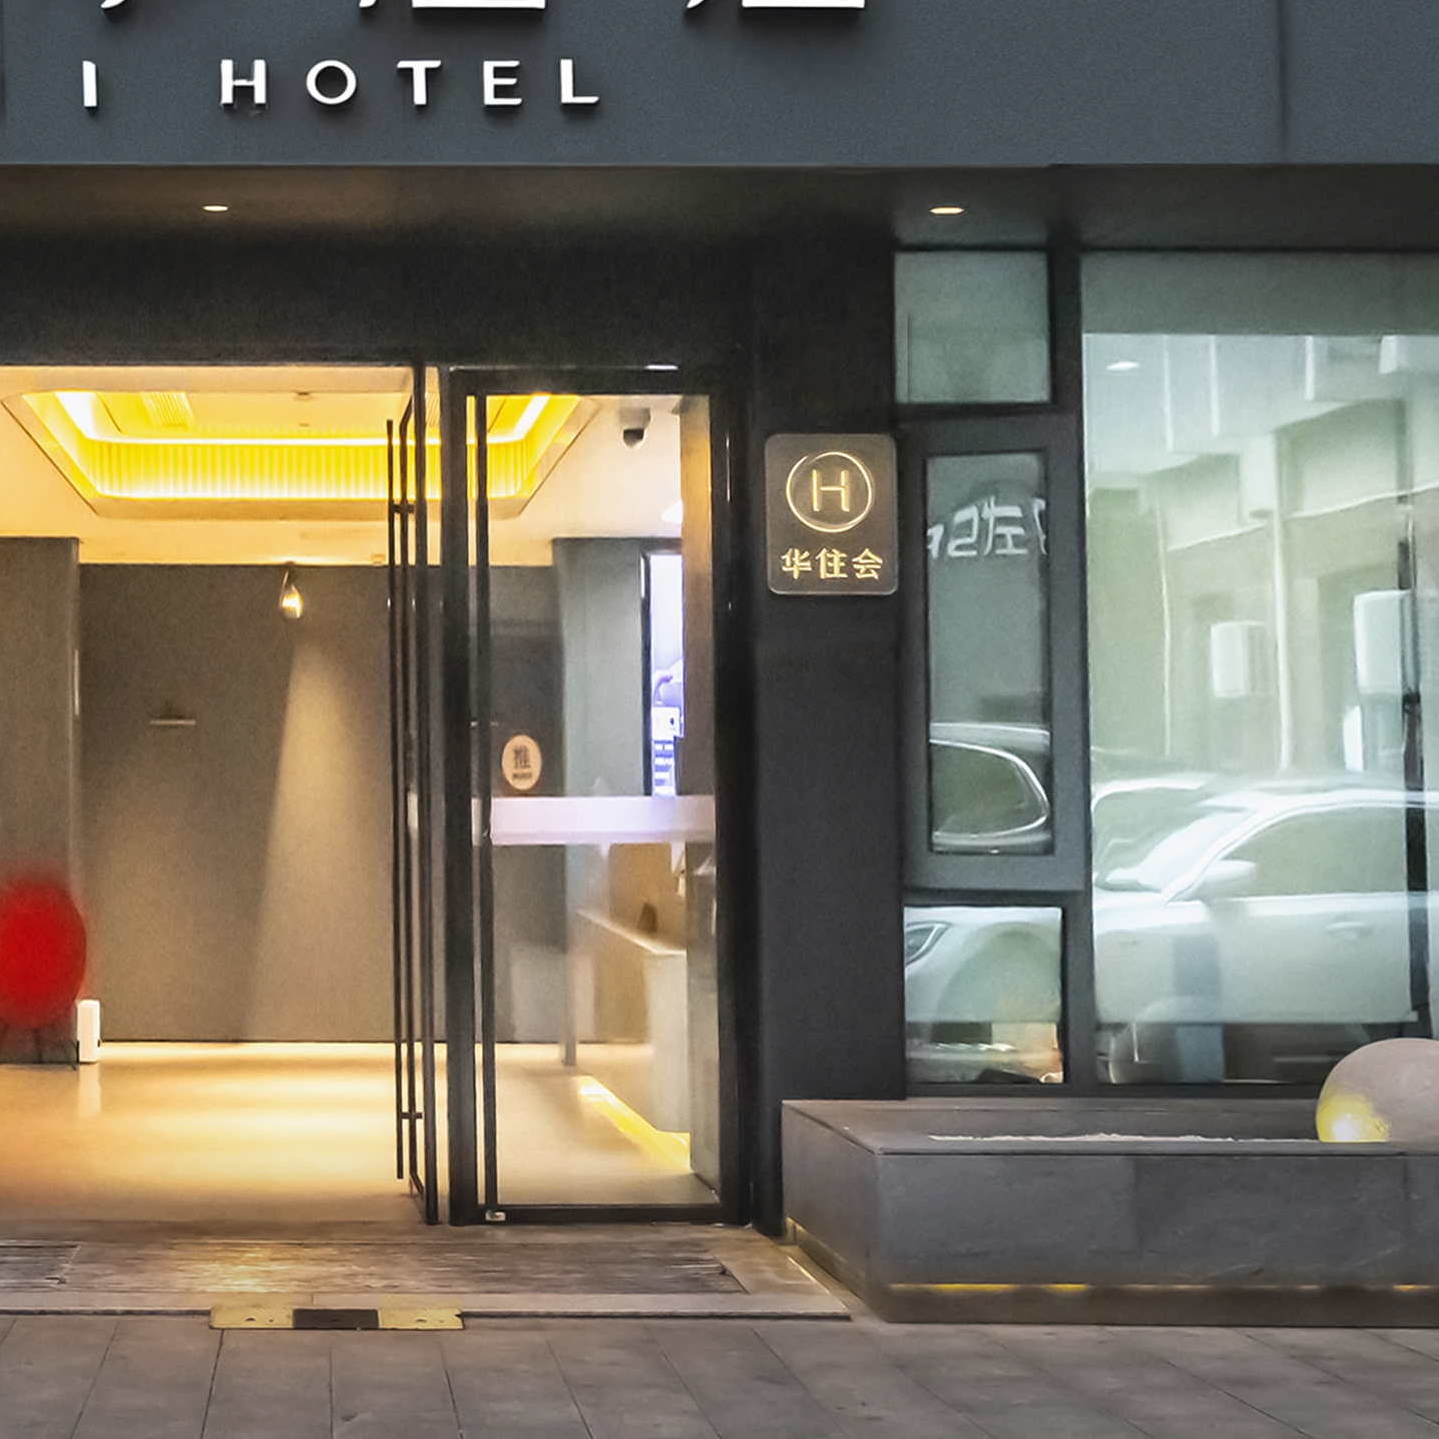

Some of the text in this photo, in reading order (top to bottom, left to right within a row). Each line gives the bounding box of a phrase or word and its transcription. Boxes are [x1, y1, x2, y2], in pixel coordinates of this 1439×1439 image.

[219, 57, 600, 107] HOTEL
[780, 547, 884, 580] 华住会
